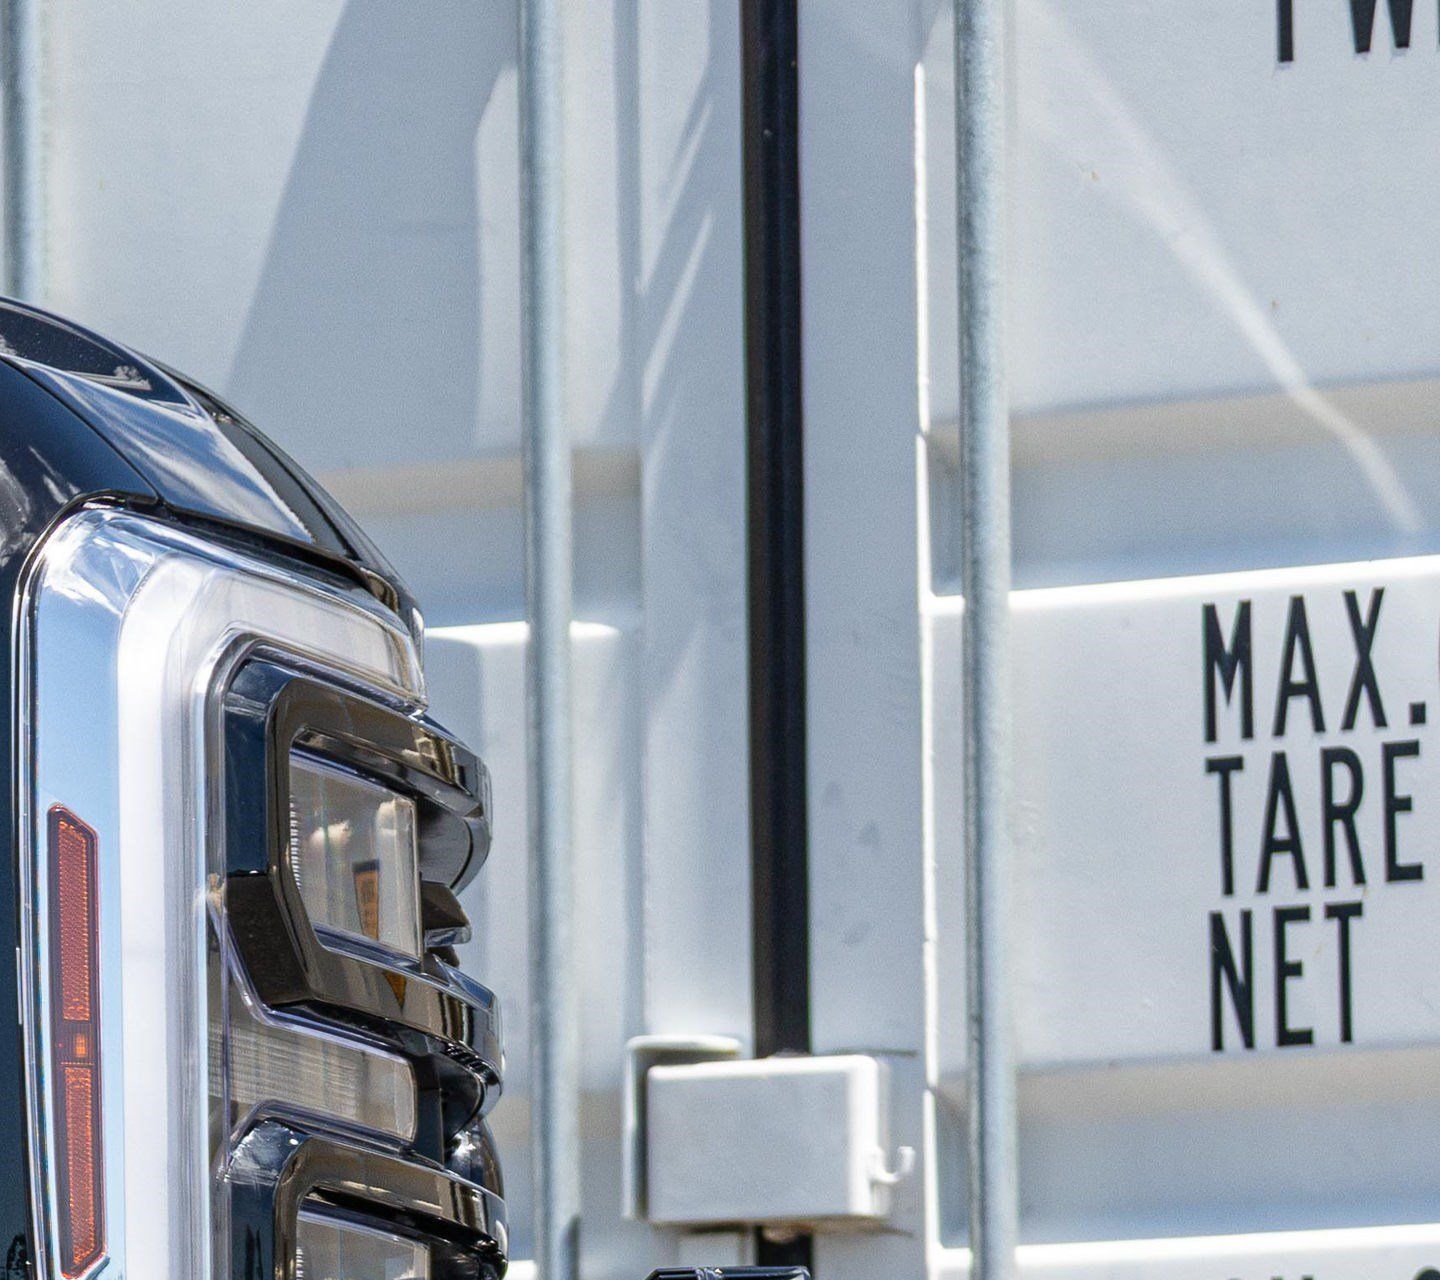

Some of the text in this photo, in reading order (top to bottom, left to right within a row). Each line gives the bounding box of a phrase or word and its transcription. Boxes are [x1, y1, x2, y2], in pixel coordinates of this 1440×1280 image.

[1201, 586, 1427, 743] MAX.
[1205, 738, 1425, 896] TARE
[1208, 901, 1364, 1052] NET
